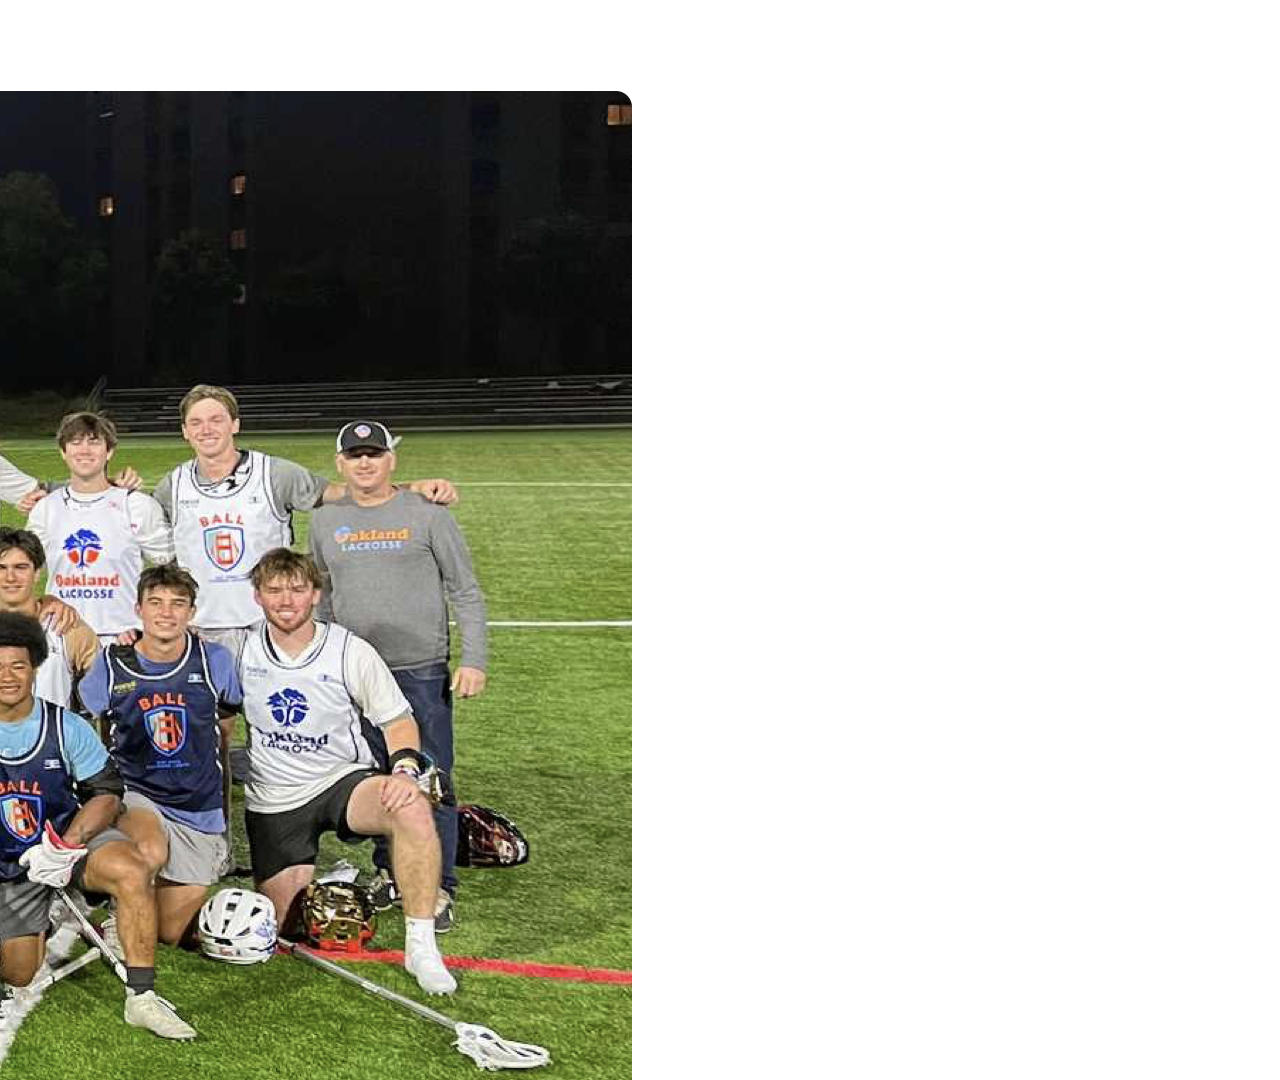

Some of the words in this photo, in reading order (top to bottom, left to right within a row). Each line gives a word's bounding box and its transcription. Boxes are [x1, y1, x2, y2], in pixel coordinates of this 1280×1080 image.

[199, 514, 245, 527] BALL
[55, 573, 121, 587] Oakland
[137, 692, 186, 711] BALL
